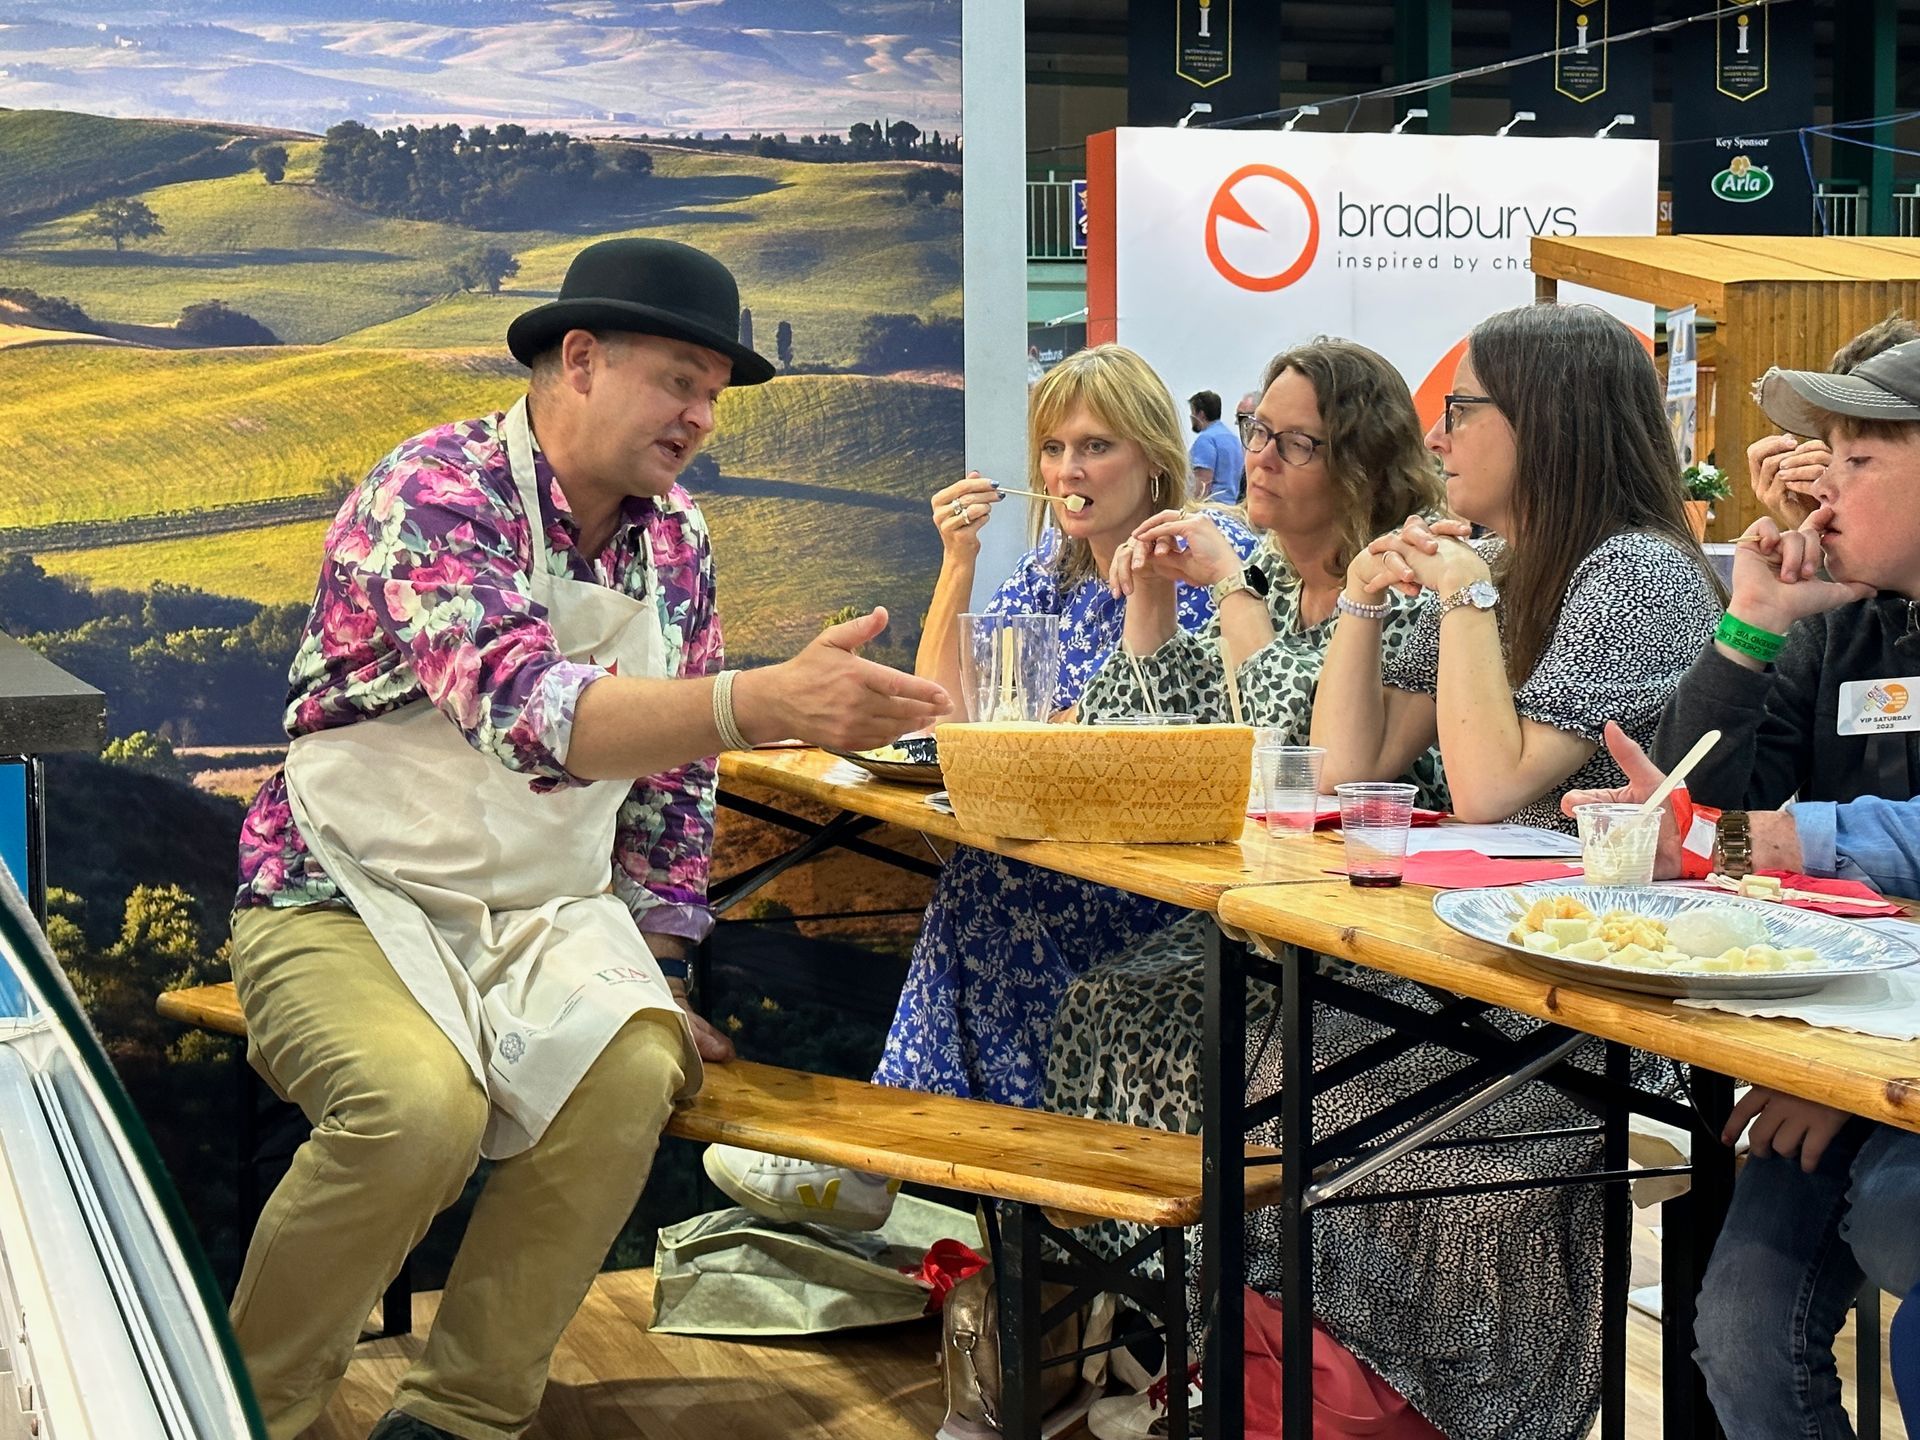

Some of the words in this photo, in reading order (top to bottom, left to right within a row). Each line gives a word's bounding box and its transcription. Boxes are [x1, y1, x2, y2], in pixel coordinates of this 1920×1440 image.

[1716, 137, 1732, 149] Key
[1734, 137, 1769, 149] Sponsor
[1721, 174, 1761, 192] Arla
[1337, 250, 1439, 271] inspired
[1453, 255, 1479, 272] by
[1874, 715, 1911, 723] SATURDAY
